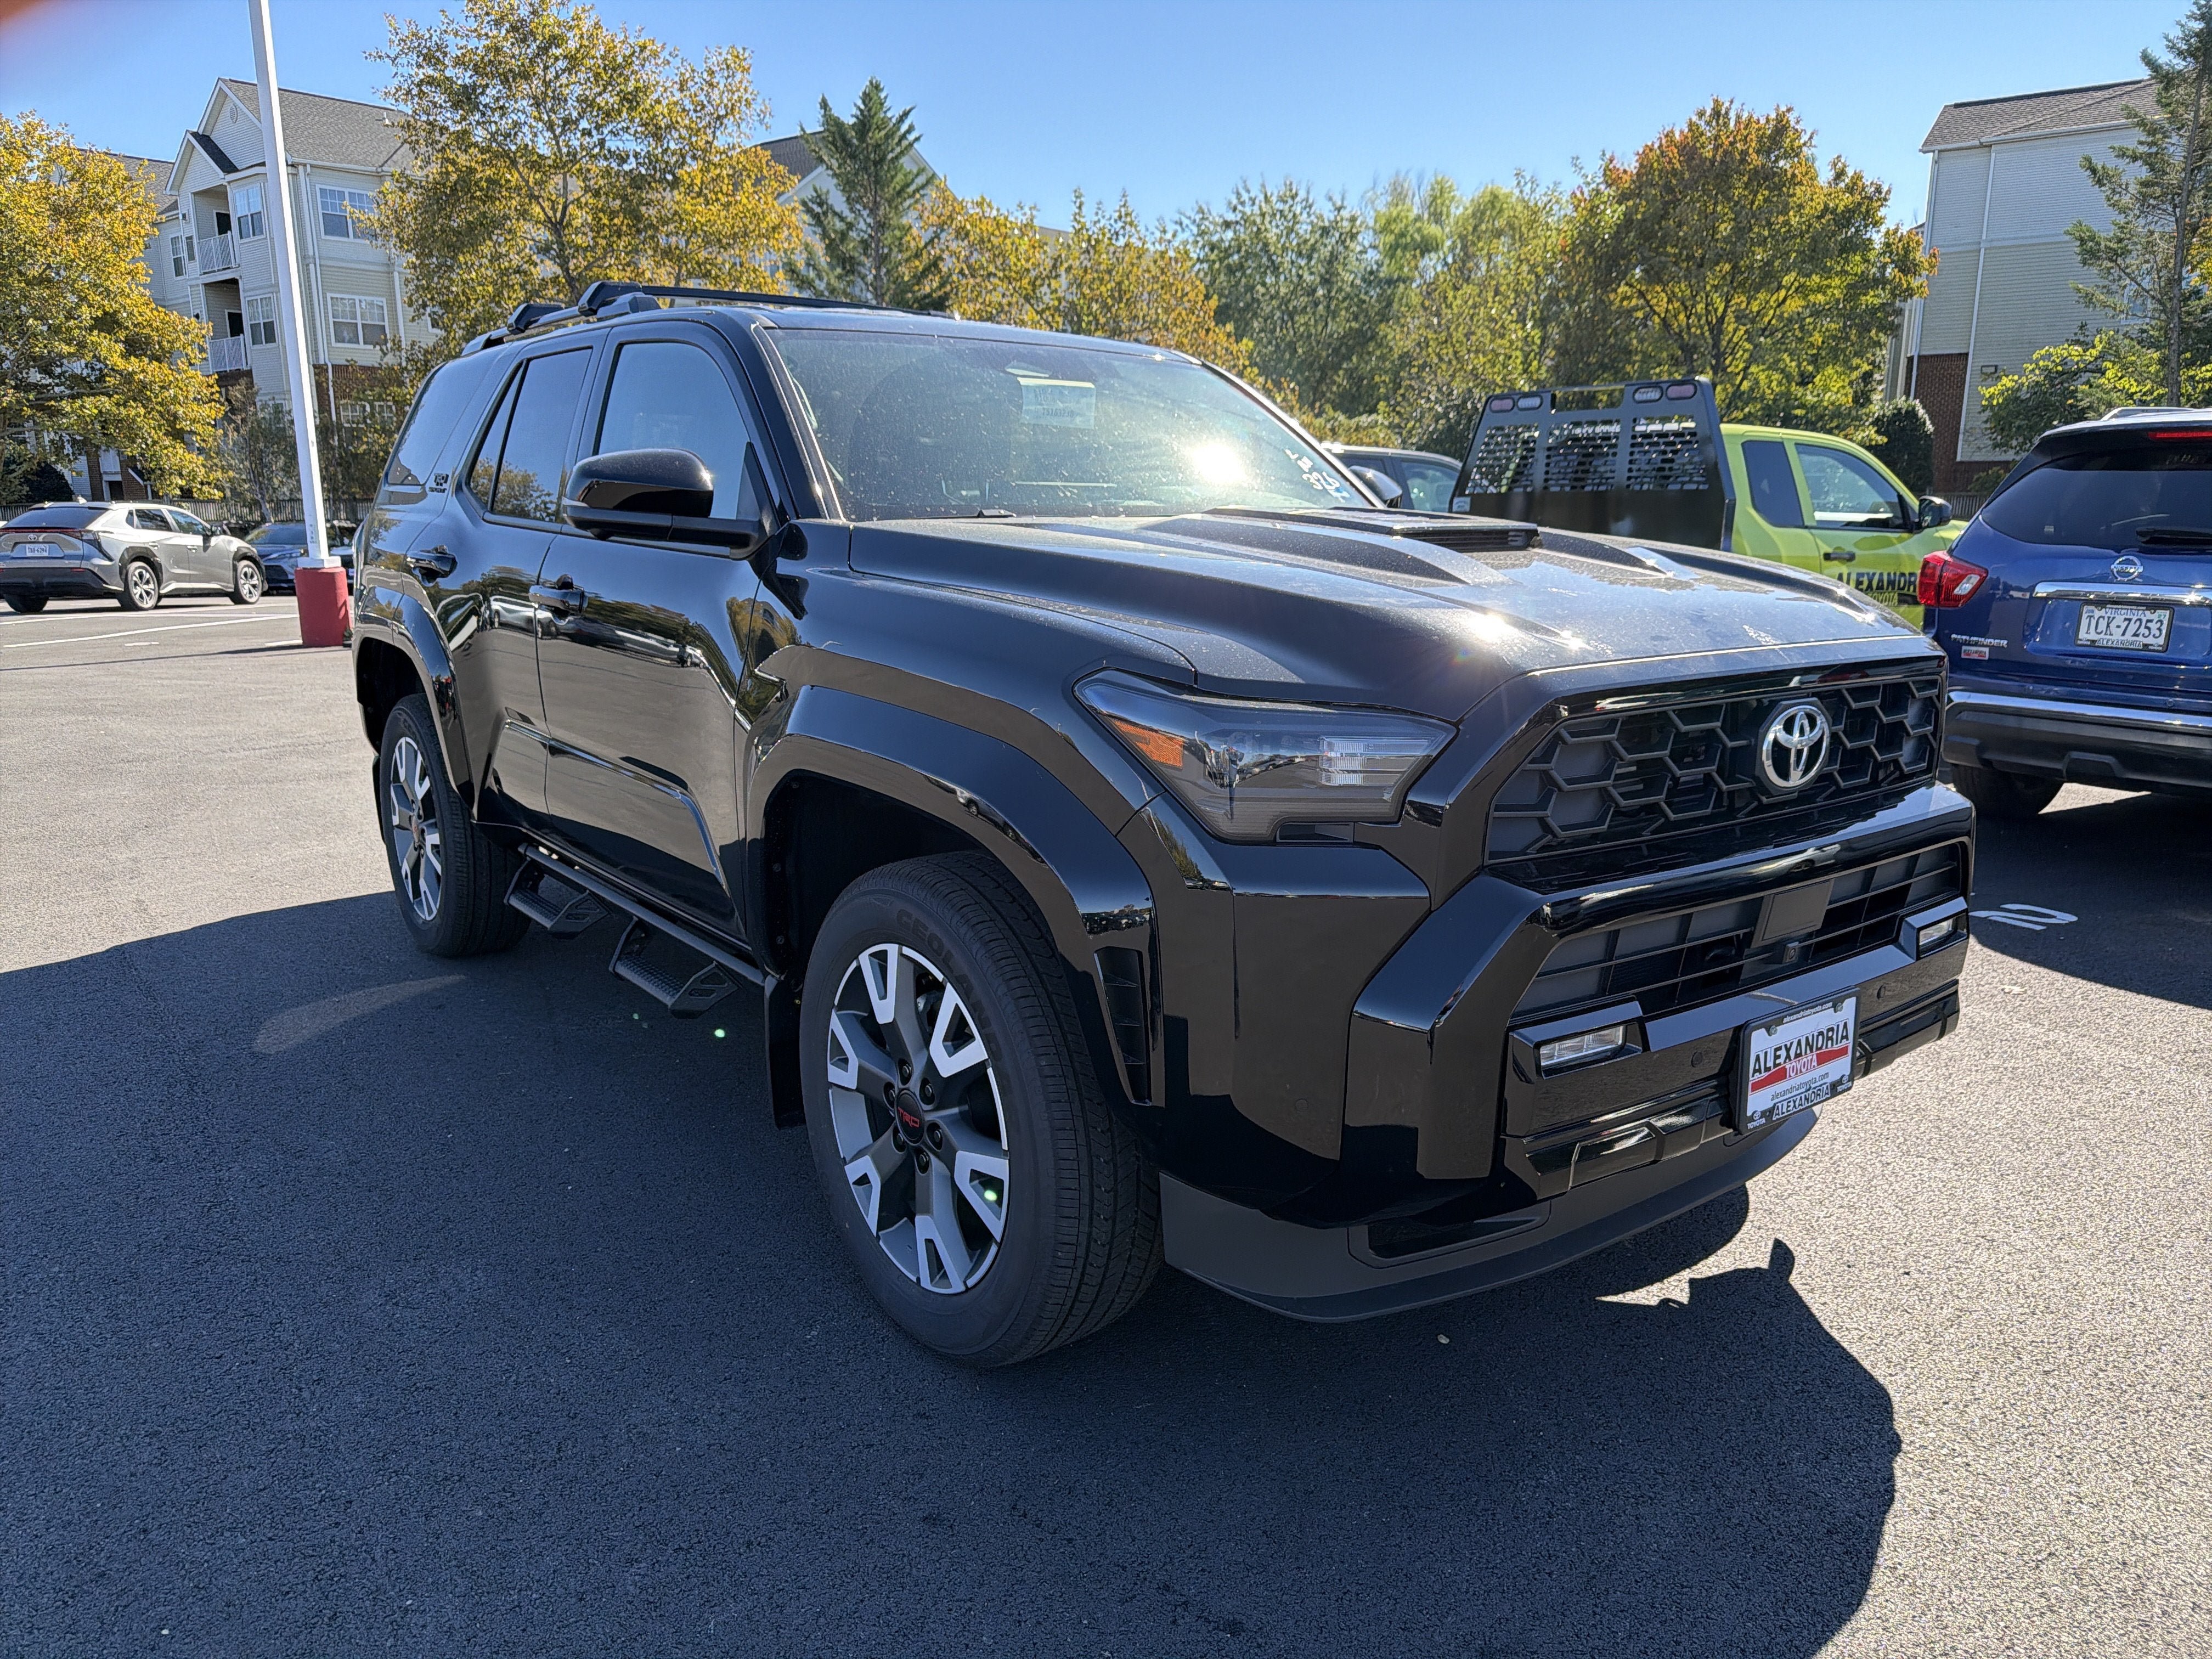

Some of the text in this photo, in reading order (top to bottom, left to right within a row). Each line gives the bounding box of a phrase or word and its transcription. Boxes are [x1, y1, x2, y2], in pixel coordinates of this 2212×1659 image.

[2104, 608, 2147, 617] VIRGINIA
[2085, 614, 2165, 639] TCK-7253
[1951, 634, 2008, 648] PATHFINDER
[2096, 638, 2143, 648] ALEXANDRIA
[1782, 1002, 1833, 1024] alexandriatoyota.com
[1752, 1021, 1849, 1078] ALEXANDRIA
[1785, 1053, 1818, 1079] TOYOTA
[1770, 1071, 1829, 1102] alexandriatoyota.com
[1836, 1081, 1852, 1093] TOYOTA
[1773, 1084, 1831, 1120] ALEXANDRIA
[1747, 1117, 1766, 1130] TOYOTA
